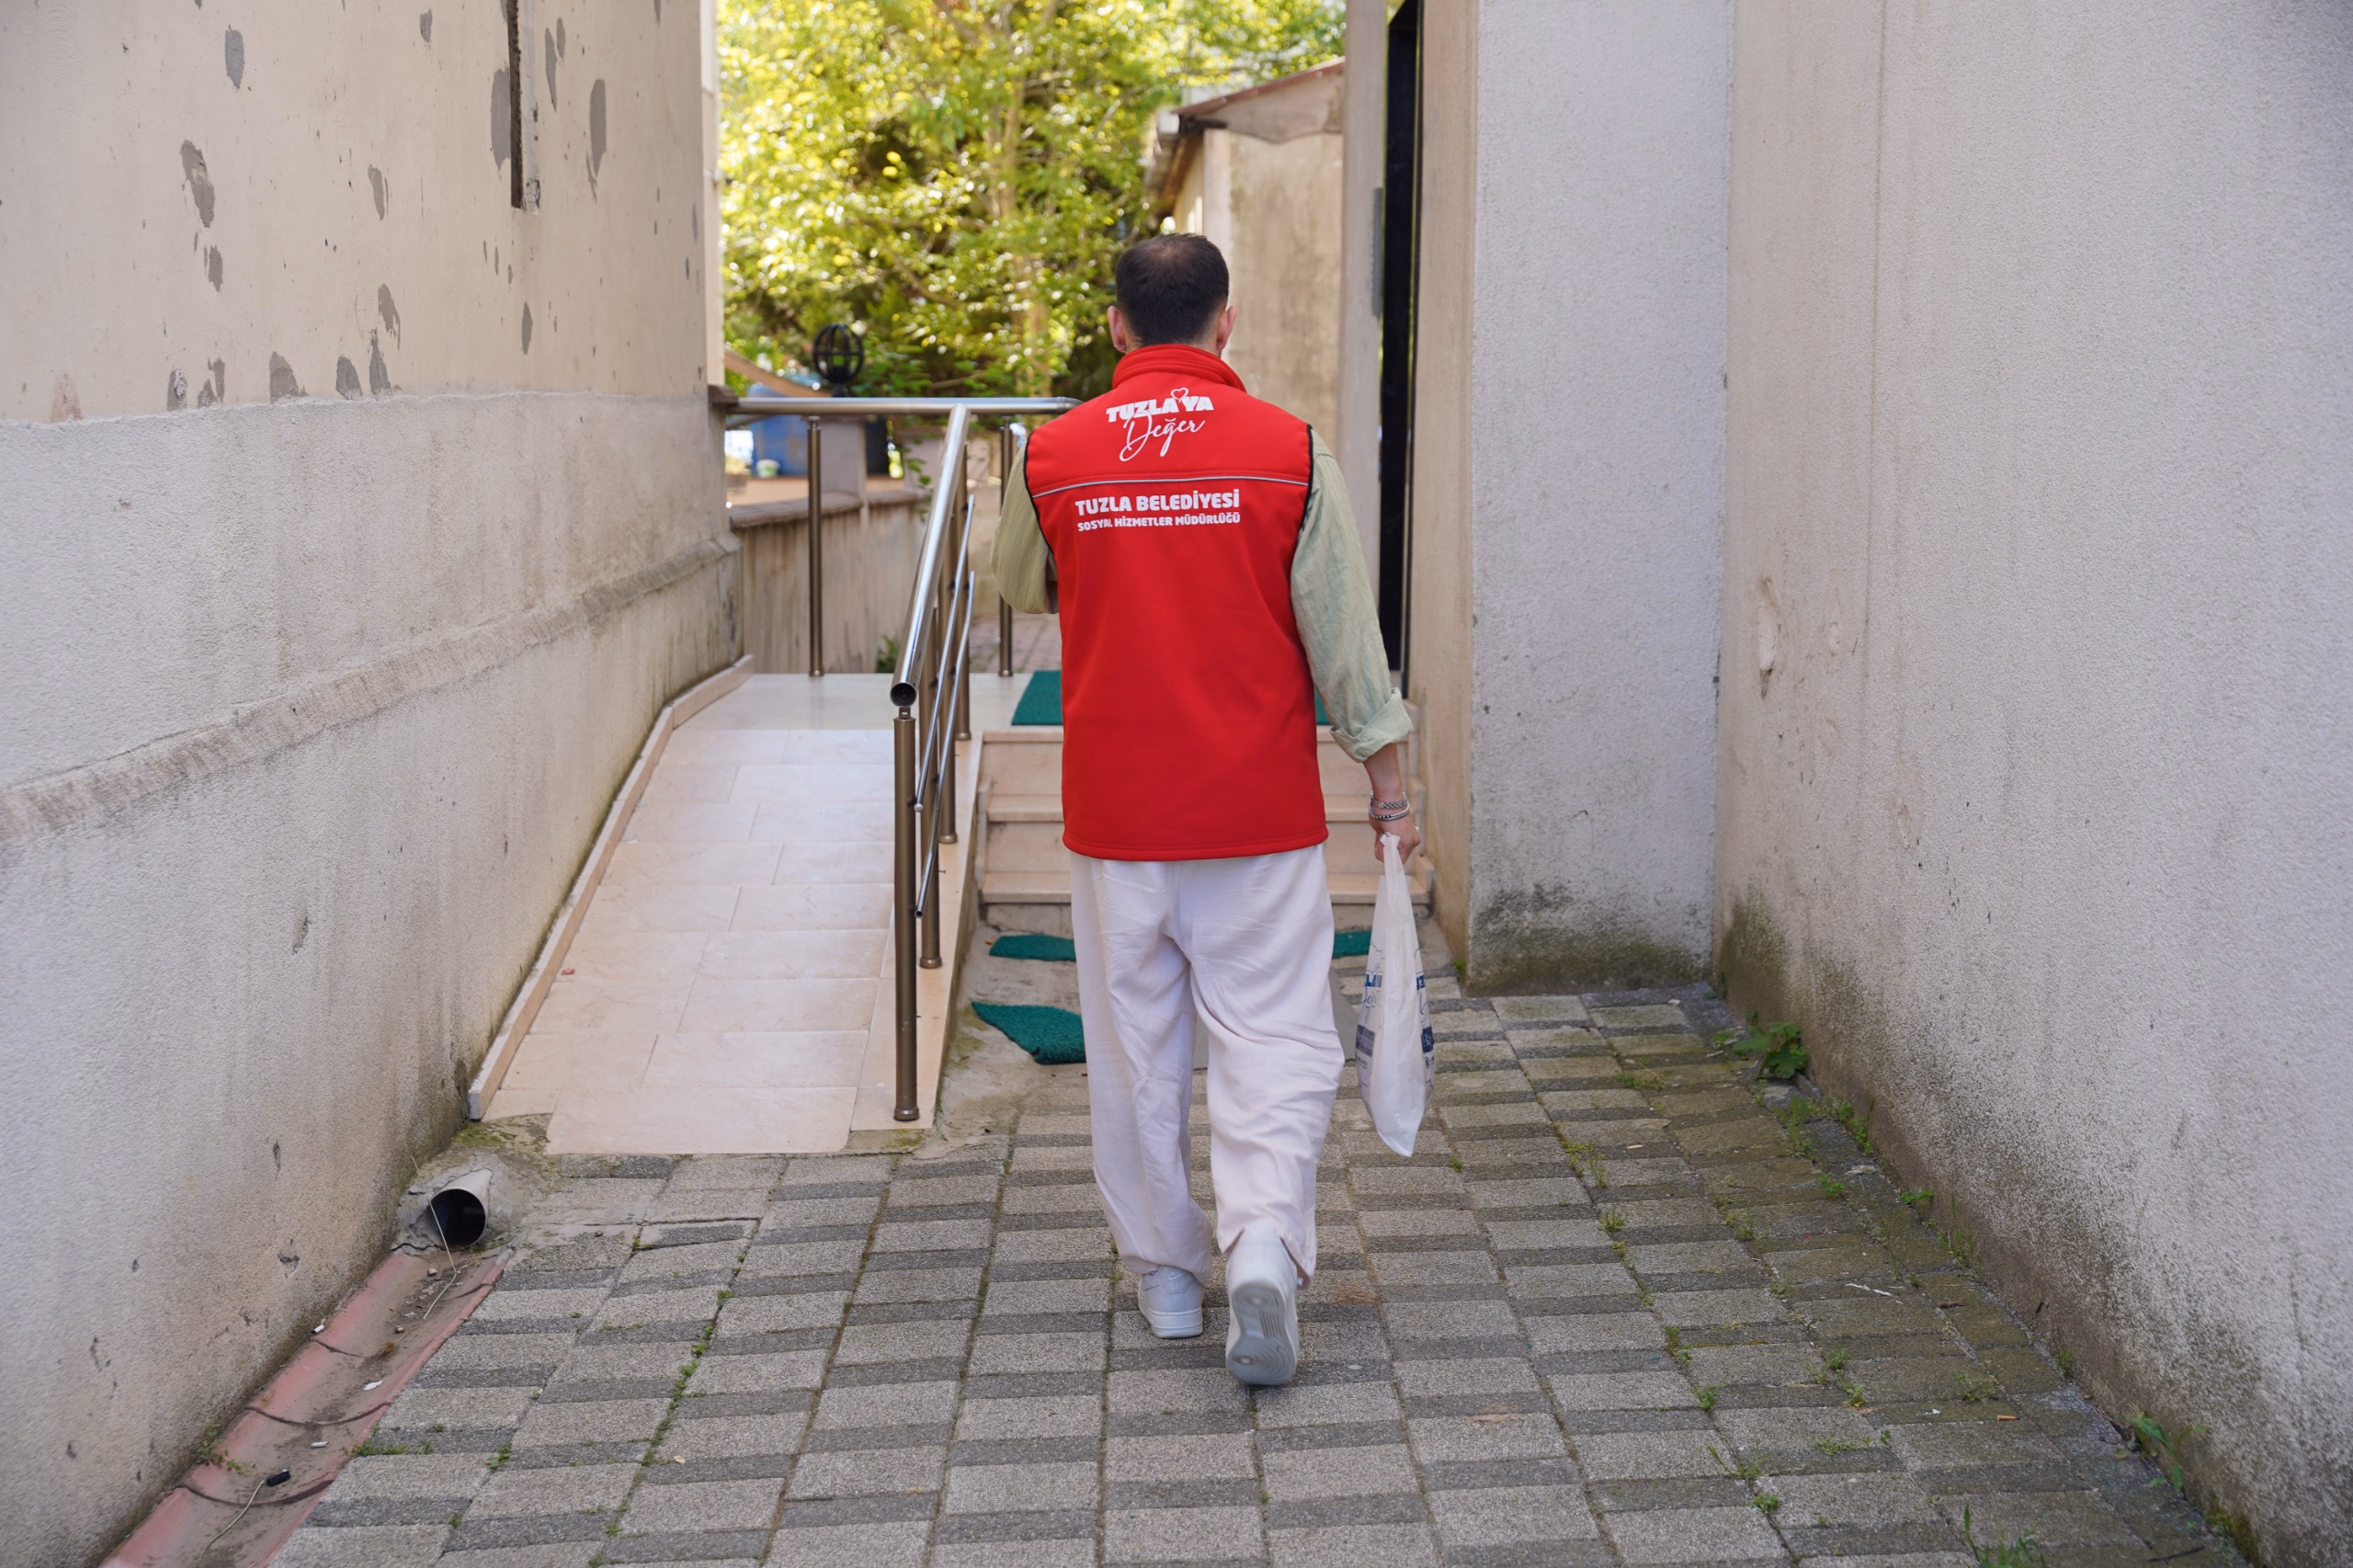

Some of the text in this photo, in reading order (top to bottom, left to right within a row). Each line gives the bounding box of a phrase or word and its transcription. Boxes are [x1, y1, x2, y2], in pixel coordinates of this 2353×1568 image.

[1120, 411, 1206, 461] Değer
[1074, 489, 1240, 516] TUZLA BELEDİYESİ
[1077, 512, 1241, 532] SOSYAL HİZMETLER MÜDÜRLÜĞÜ
